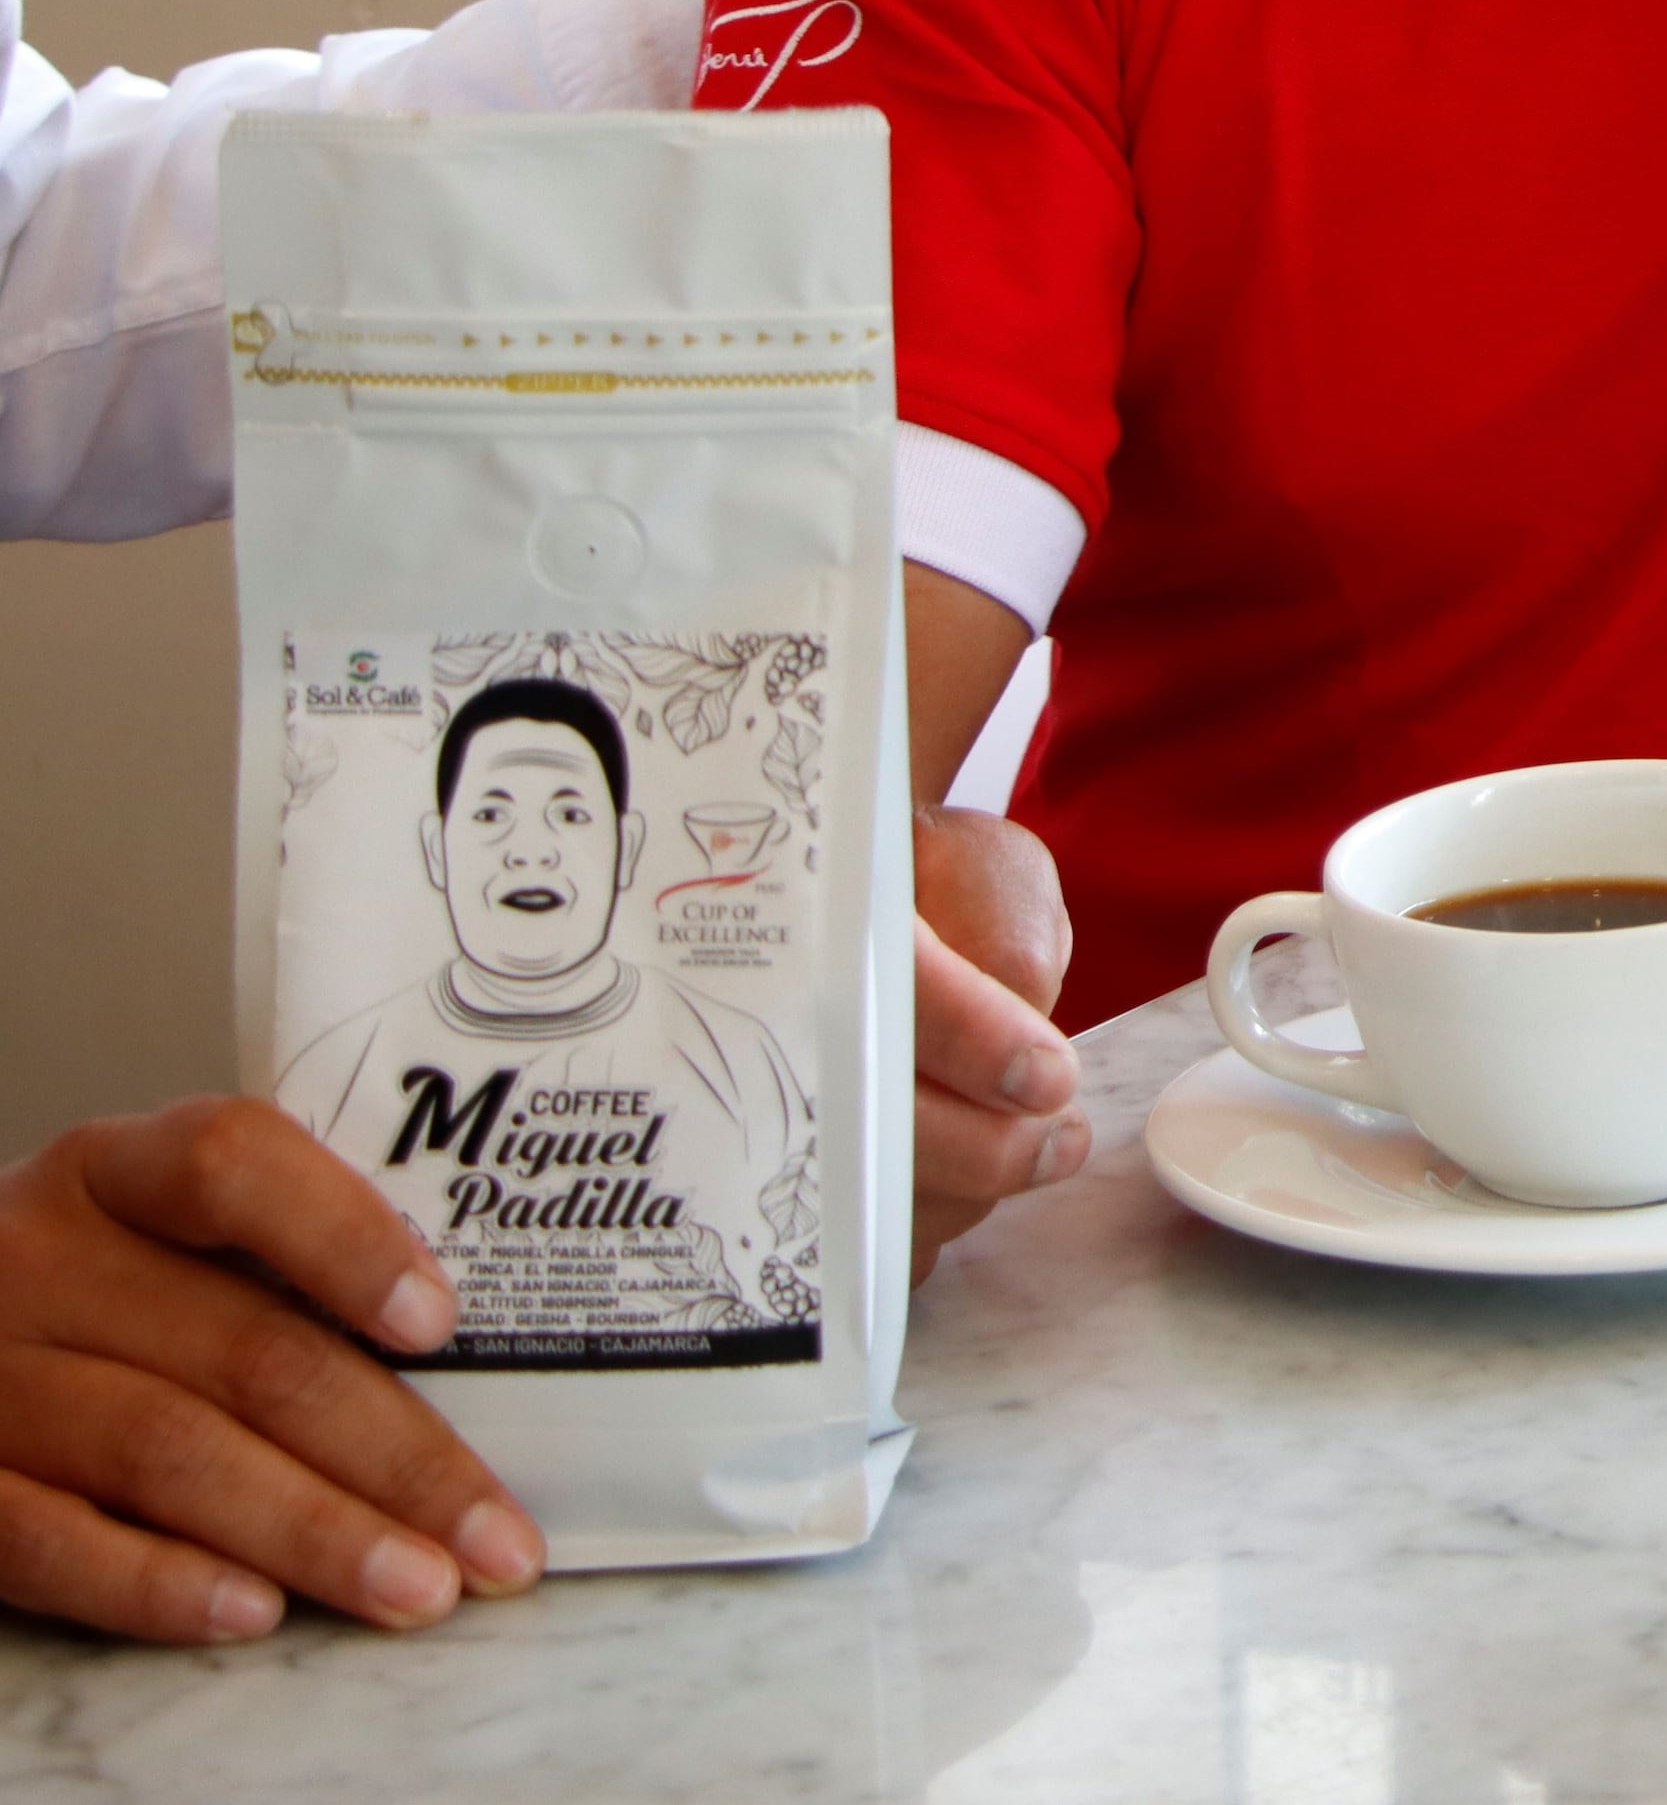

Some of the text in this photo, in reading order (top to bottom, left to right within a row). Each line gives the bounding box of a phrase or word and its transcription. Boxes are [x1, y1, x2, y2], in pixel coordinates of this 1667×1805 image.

[306, 683, 342, 706] Sol
[346, 685, 362, 706] &
[682, 901, 728, 922] CUP
[657, 923, 791, 945] EXCELLENCE
[529, 1089, 652, 1118] COFFEE
[384, 1064, 668, 1180] Miguel
[446, 1171, 687, 1231] Padilla
[489, 1246, 544, 1260] MIGUEL
[551, 1246, 617, 1260] PADILLA
[524, 1262, 541, 1276] EL
[546, 1262, 618, 1276] MIRADOR
[511, 1278, 544, 1293] SAN
[617, 1278, 718, 1293] CAJAMARCA
[515, 1312, 571, 1326] GEISHA
[585, 1312, 661, 1326] BOURBON
[473, 1337, 511, 1354] SAN
[514, 1337, 585, 1354] IGNACIO
[601, 1335, 713, 1353] CAJAMARCA
